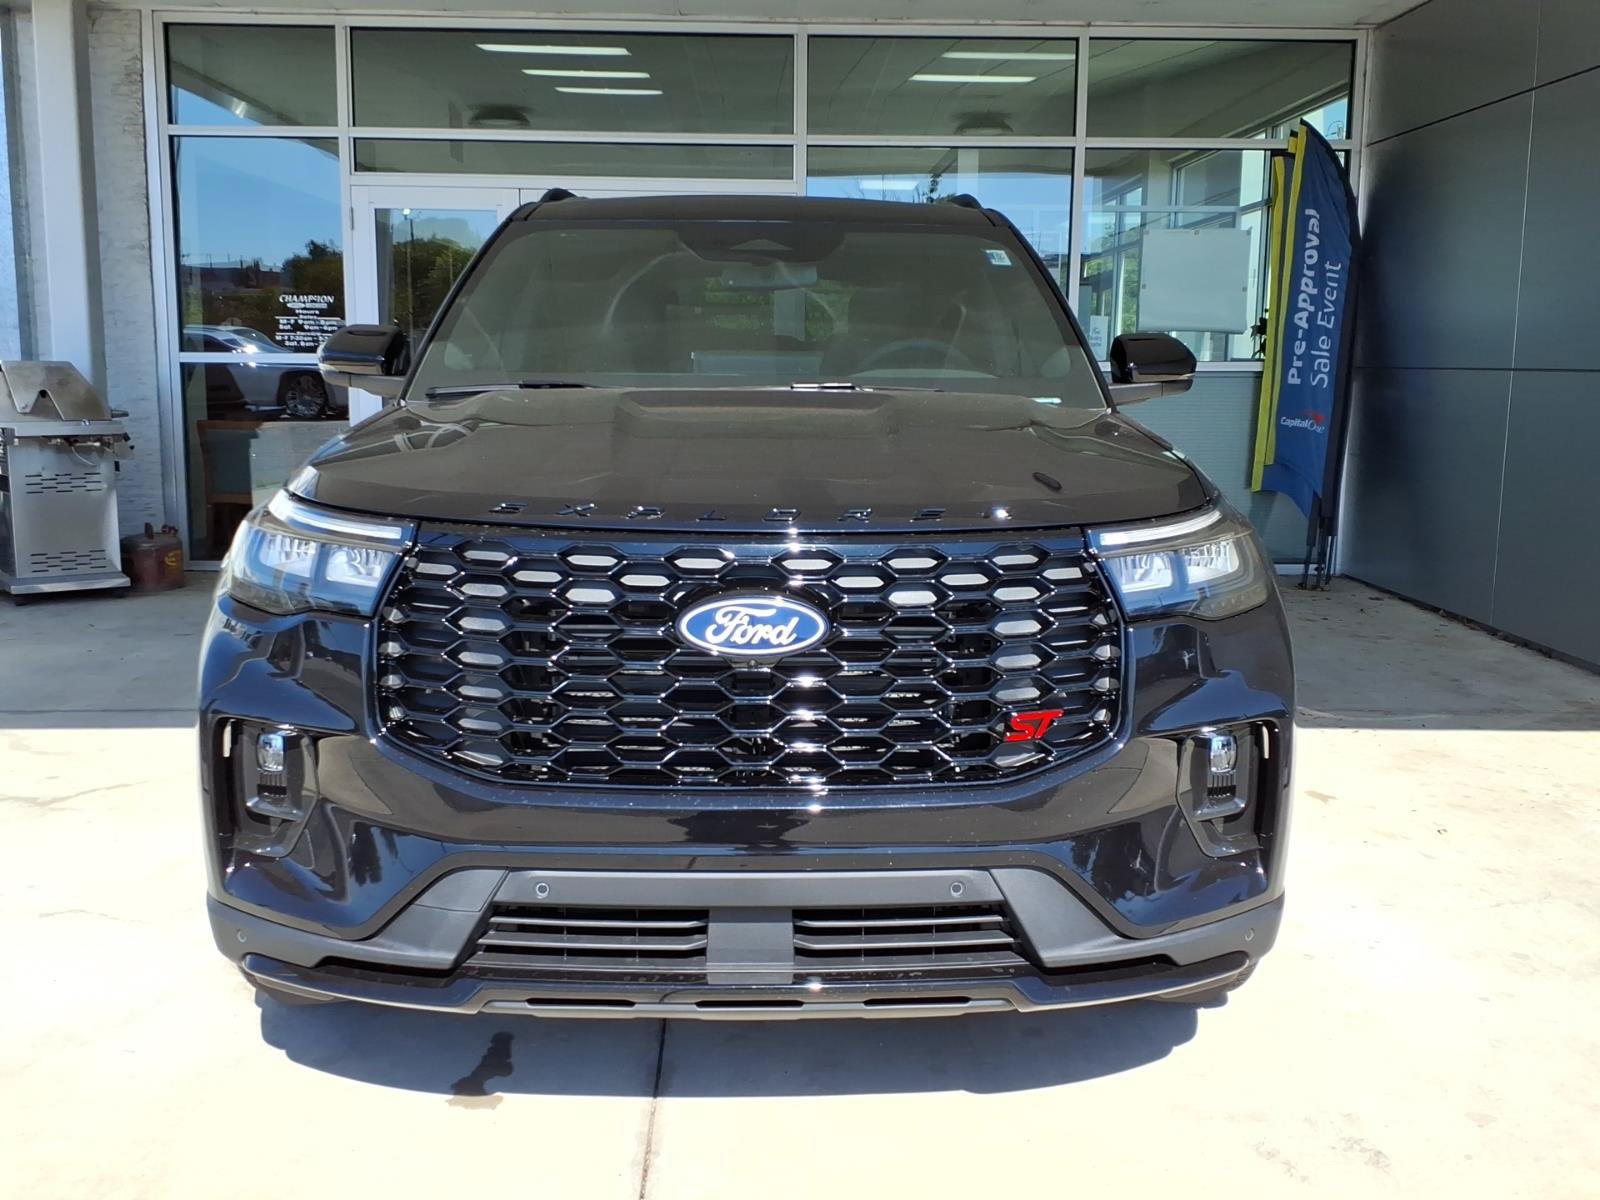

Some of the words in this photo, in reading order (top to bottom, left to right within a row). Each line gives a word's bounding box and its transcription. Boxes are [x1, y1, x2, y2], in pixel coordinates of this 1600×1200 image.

[279, 294, 334, 303] CHAMPION
[1287, 208, 1320, 385] Pre-Approval
[1316, 260, 1342, 329] Event
[1310, 335, 1332, 388] Sale
[705, 605, 800, 646] Ford
[1004, 709, 1065, 743] ST
